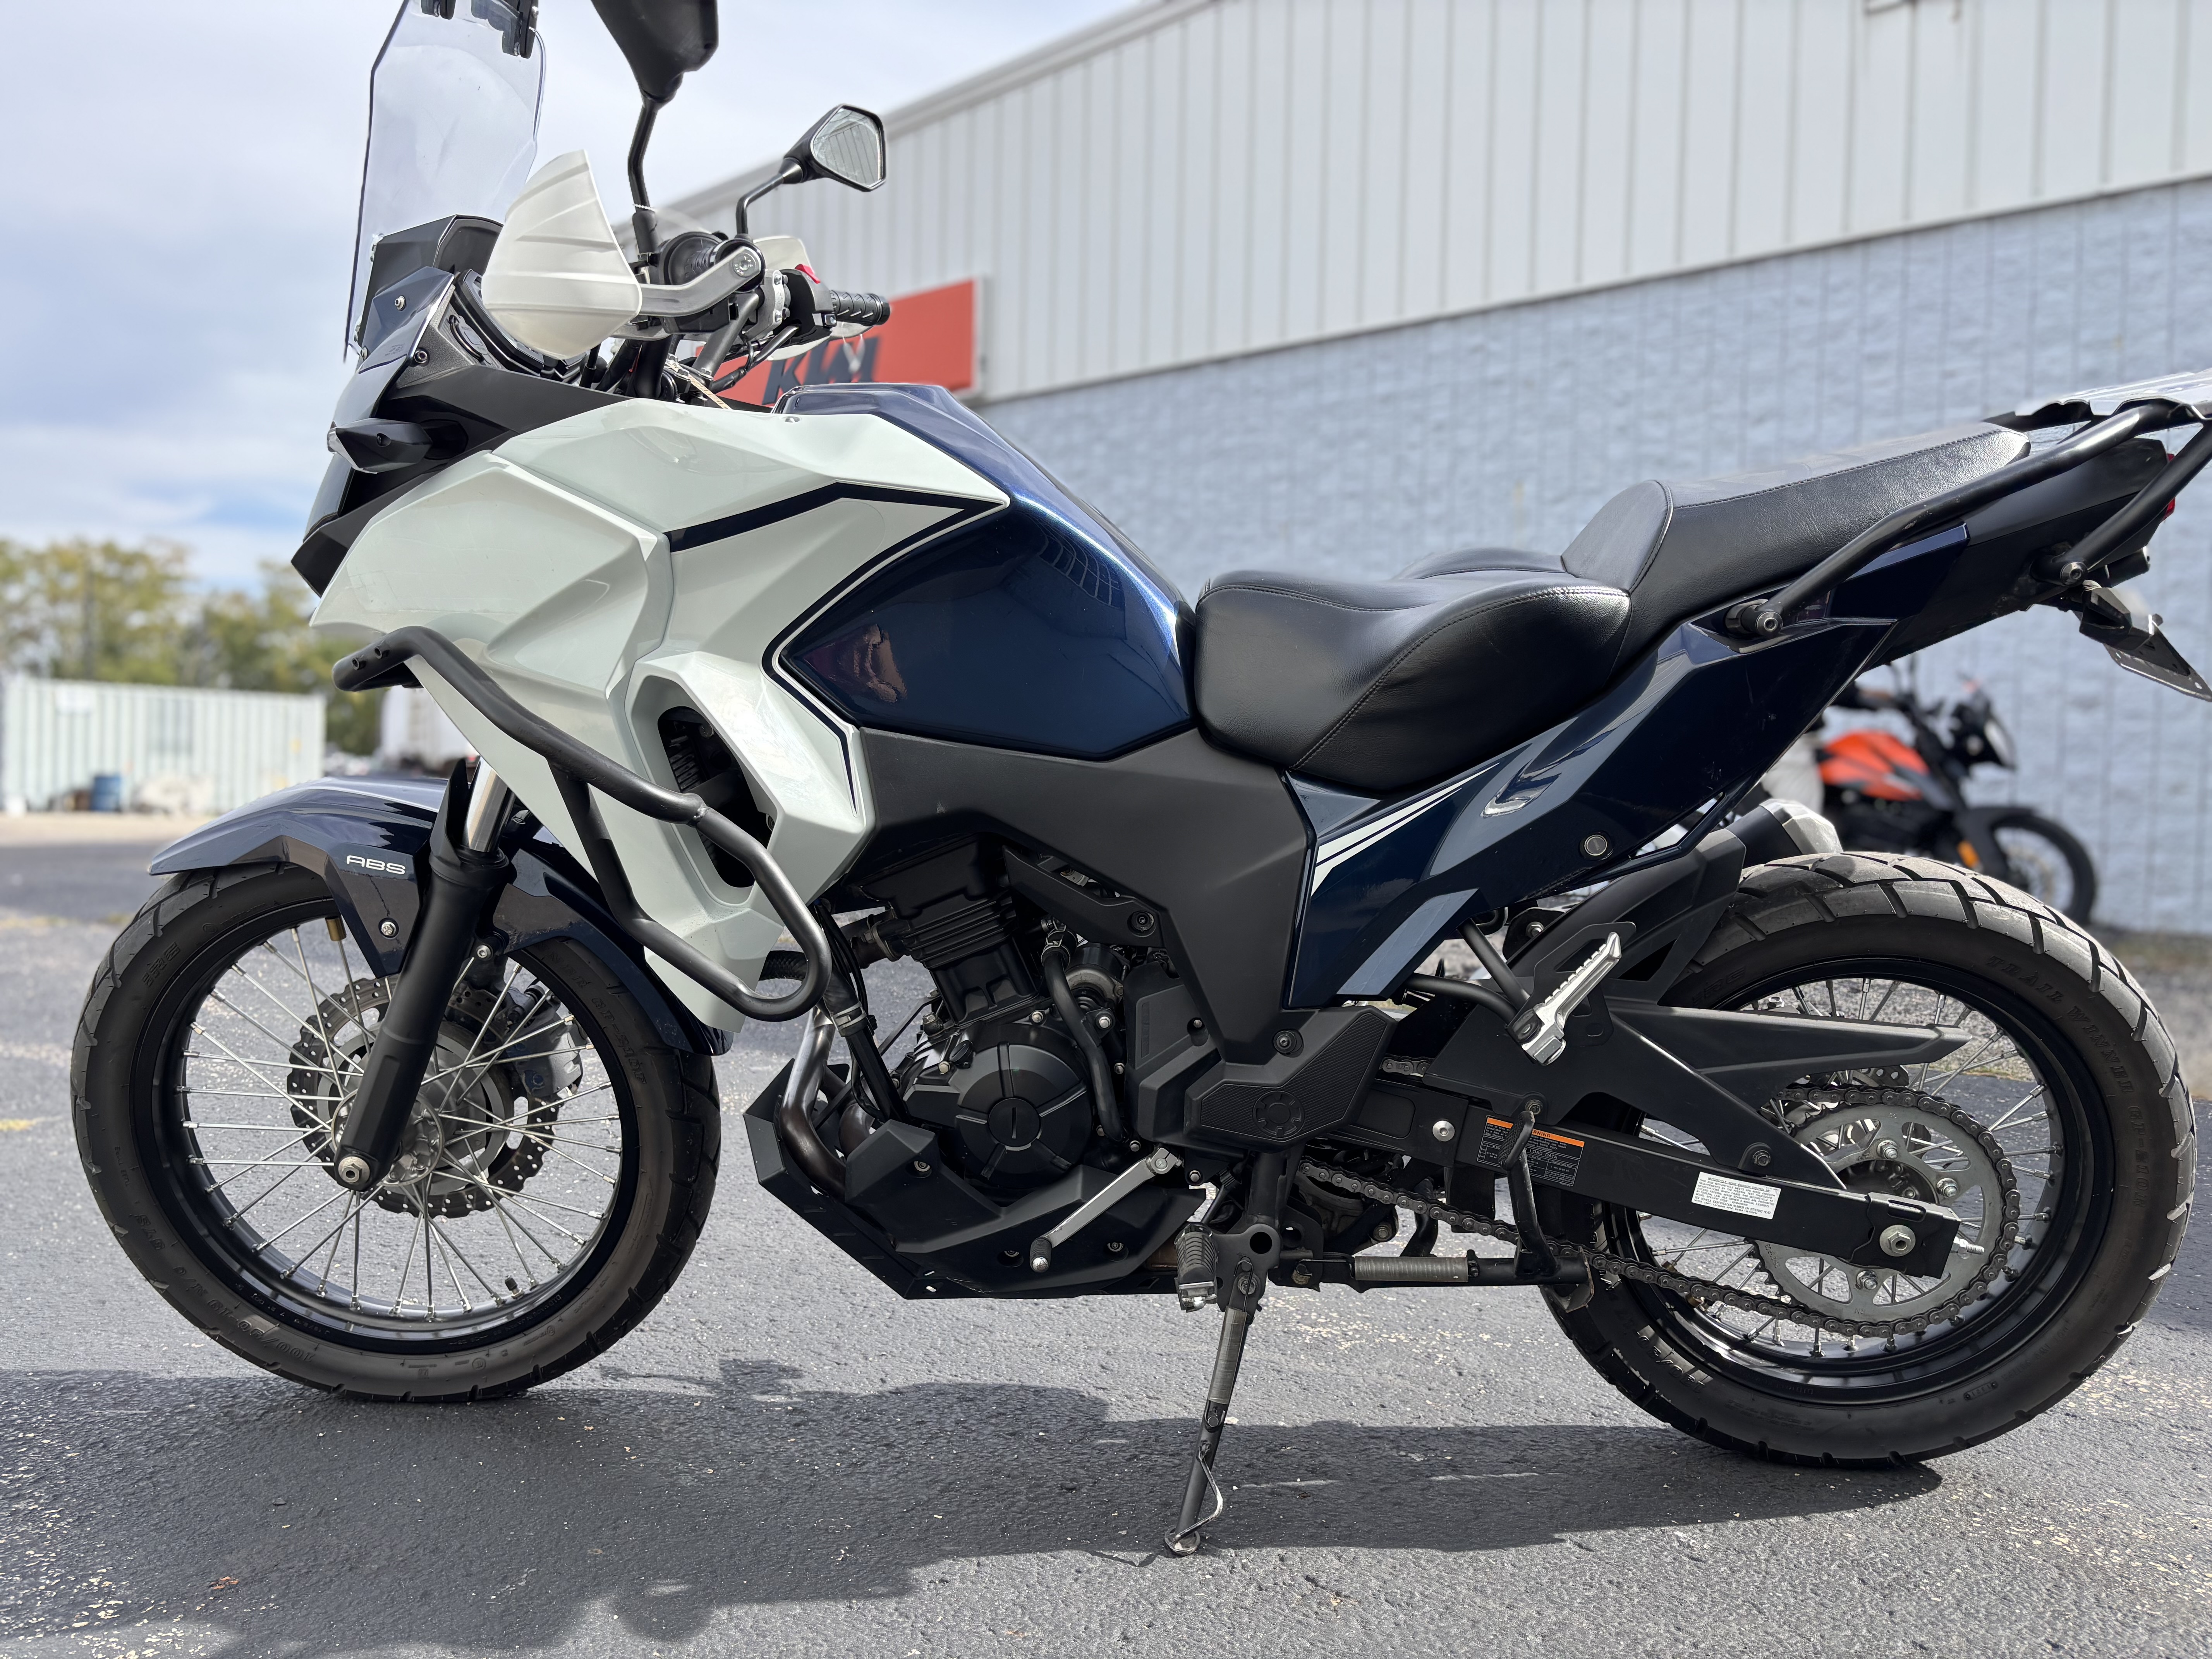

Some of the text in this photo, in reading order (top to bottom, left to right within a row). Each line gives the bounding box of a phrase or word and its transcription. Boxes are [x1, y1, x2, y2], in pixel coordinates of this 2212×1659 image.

[347, 855, 406, 874] ABS
[1985, 955, 2065, 1004] TRAIL
[2066, 1005, 2135, 1095] WINNER
[1532, 1129, 1551, 1138] RNING
[208, 1298, 315, 1363] 100/90-19
